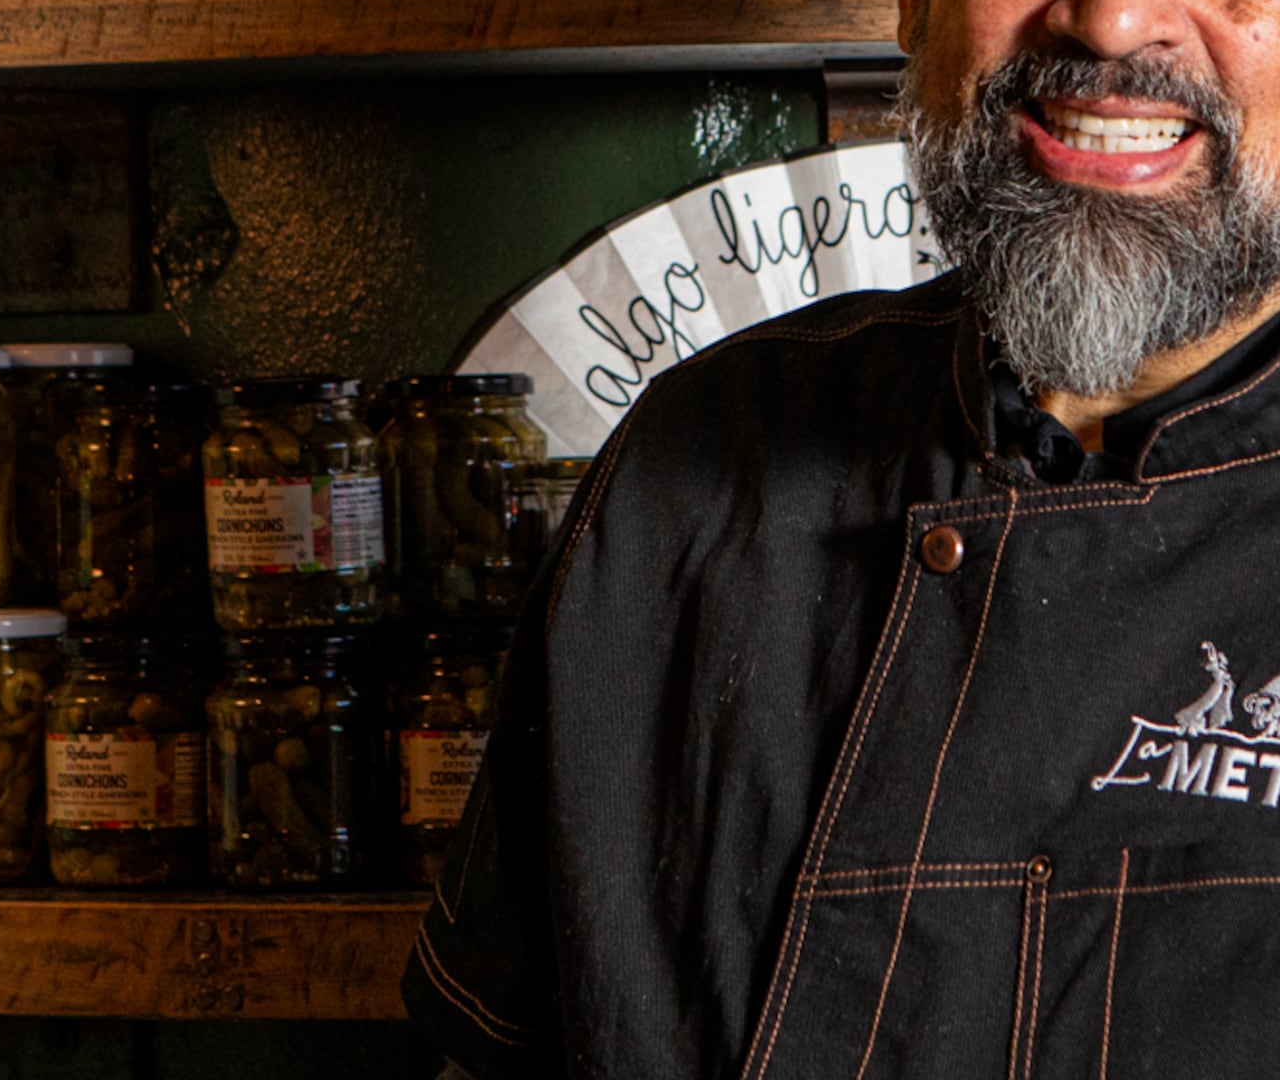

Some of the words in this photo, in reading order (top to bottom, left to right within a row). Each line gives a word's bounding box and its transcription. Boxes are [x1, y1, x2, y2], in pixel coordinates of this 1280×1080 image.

[579, 261, 705, 408] algo
[222, 490, 265, 506] Roland
[65, 745, 109, 762] Roland
[441, 742, 483, 759] Rolan
[1091, 715, 1172, 791] La
